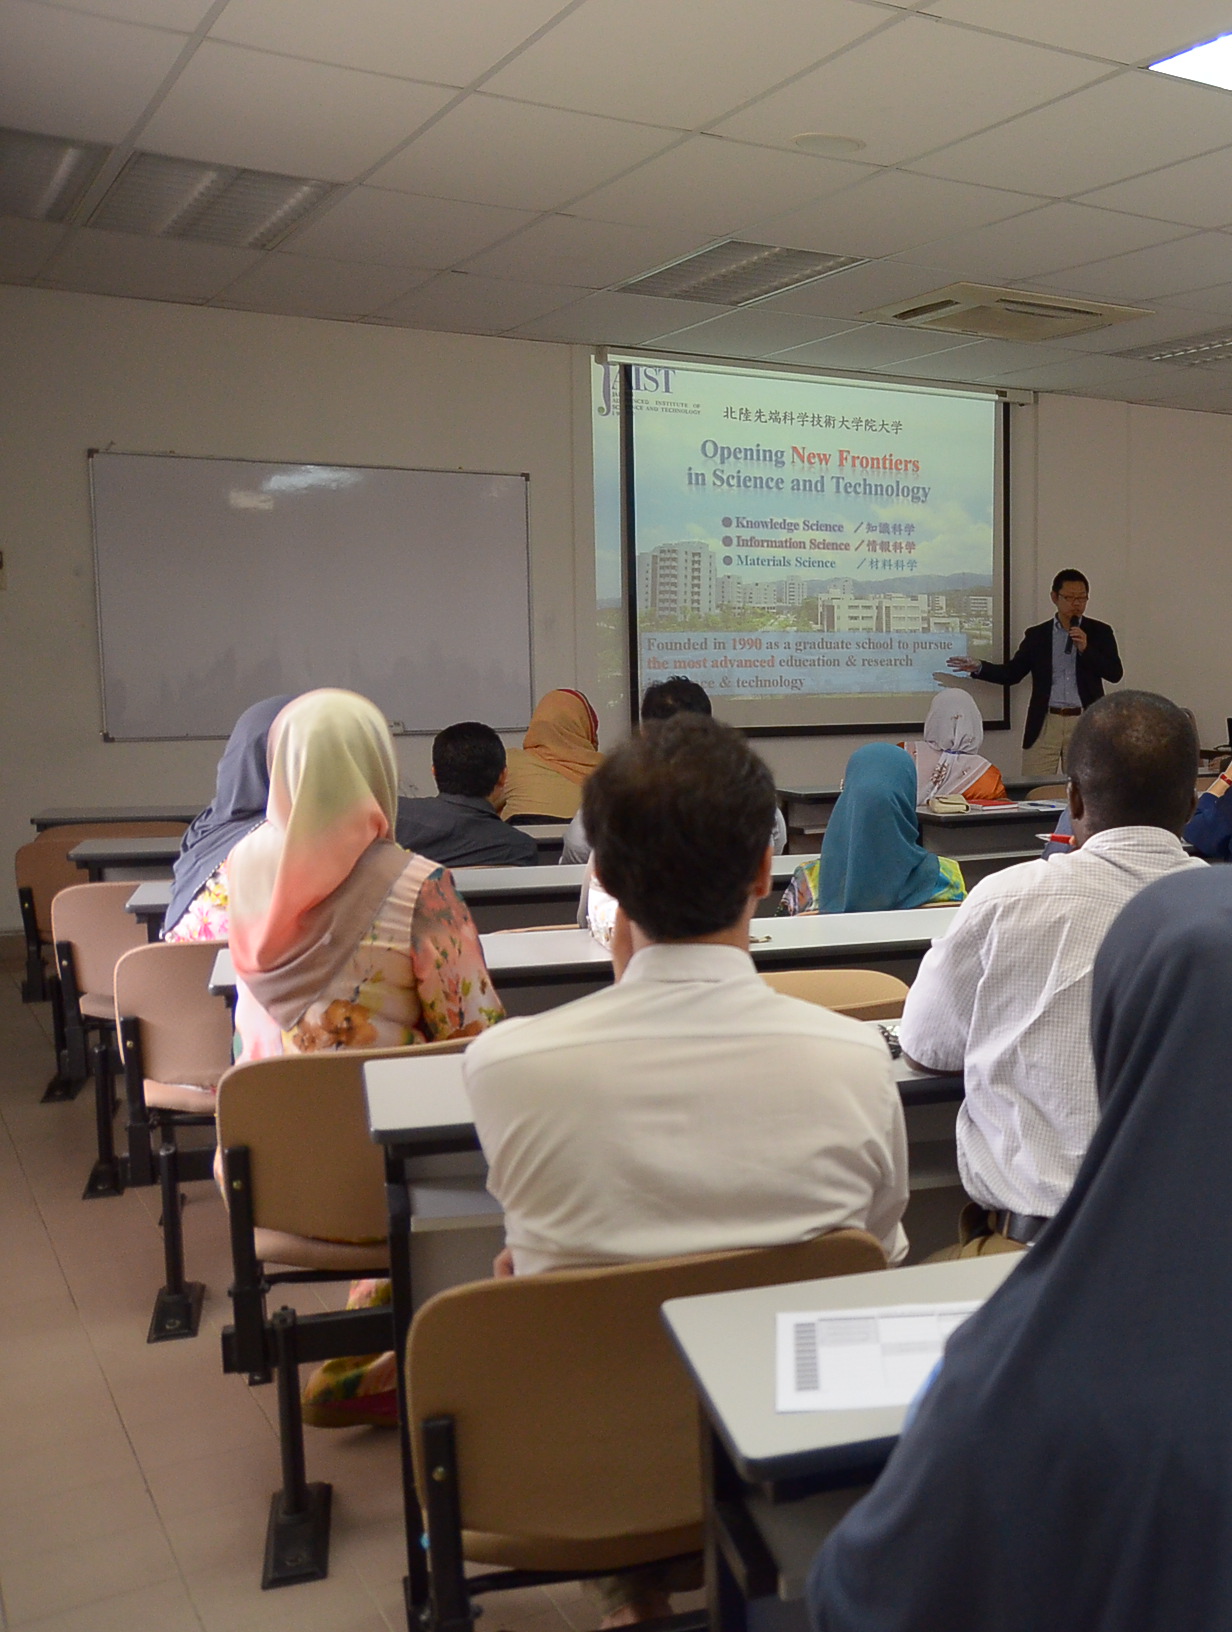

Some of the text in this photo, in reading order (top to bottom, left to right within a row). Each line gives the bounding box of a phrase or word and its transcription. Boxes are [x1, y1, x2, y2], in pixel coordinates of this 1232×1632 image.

[655, 400, 688, 408] INSTITUTE
[661, 407, 701, 415] TECHNOLOGY
[723, 406, 903, 435] 北陸先端科学技術大学院大学
[701, 439, 921, 473] Opening New Frontiers
[687, 467, 931, 503] in Science and Technology
[735, 516, 800, 533] Knowledge
[802, 520, 844, 533] Science
[736, 535, 806, 550] Information
[809, 539, 851, 551] Science
[736, 555, 791, 567] Materials
[795, 557, 836, 569] Science
[647, 637, 953, 652] Founded in 1990 as a graduate school to pursue
[647, 655, 913, 669] the most advanced education & research
[719, 677, 731, 688] &
[736, 676, 805, 690] technology
